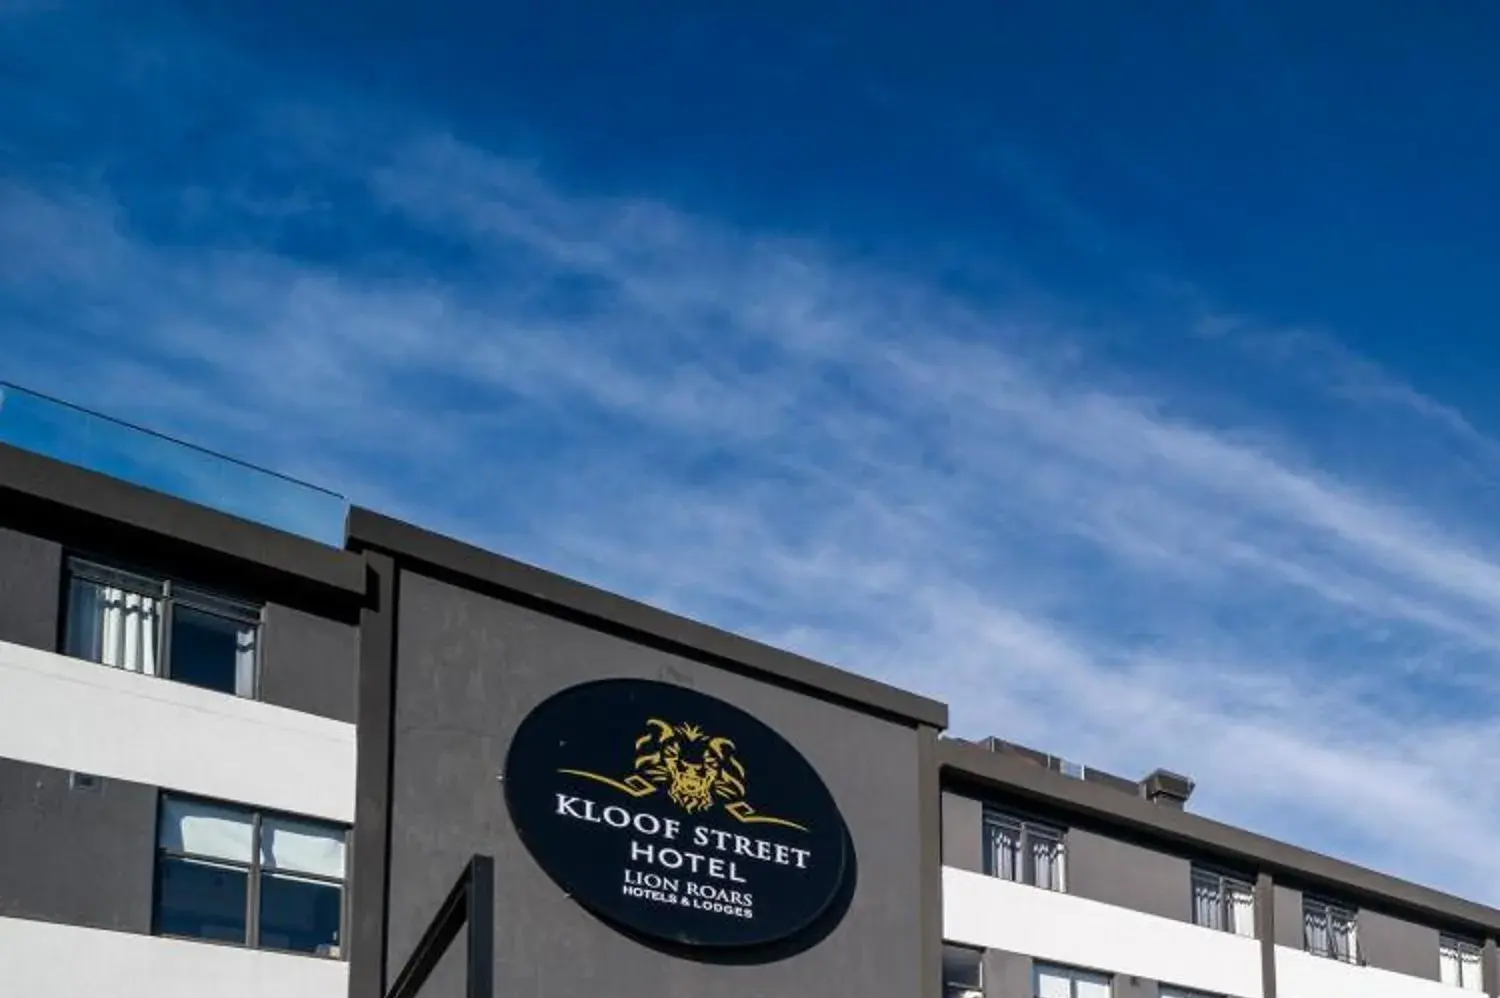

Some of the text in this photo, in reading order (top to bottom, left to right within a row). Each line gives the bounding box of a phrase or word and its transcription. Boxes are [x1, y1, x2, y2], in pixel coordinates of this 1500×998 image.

[556, 794, 811, 869] KLOOF STREET
[630, 840, 747, 883] HOTEL
[623, 885, 753, 919] HOTELS & LODGES
[624, 869, 753, 907] LION ROARS
